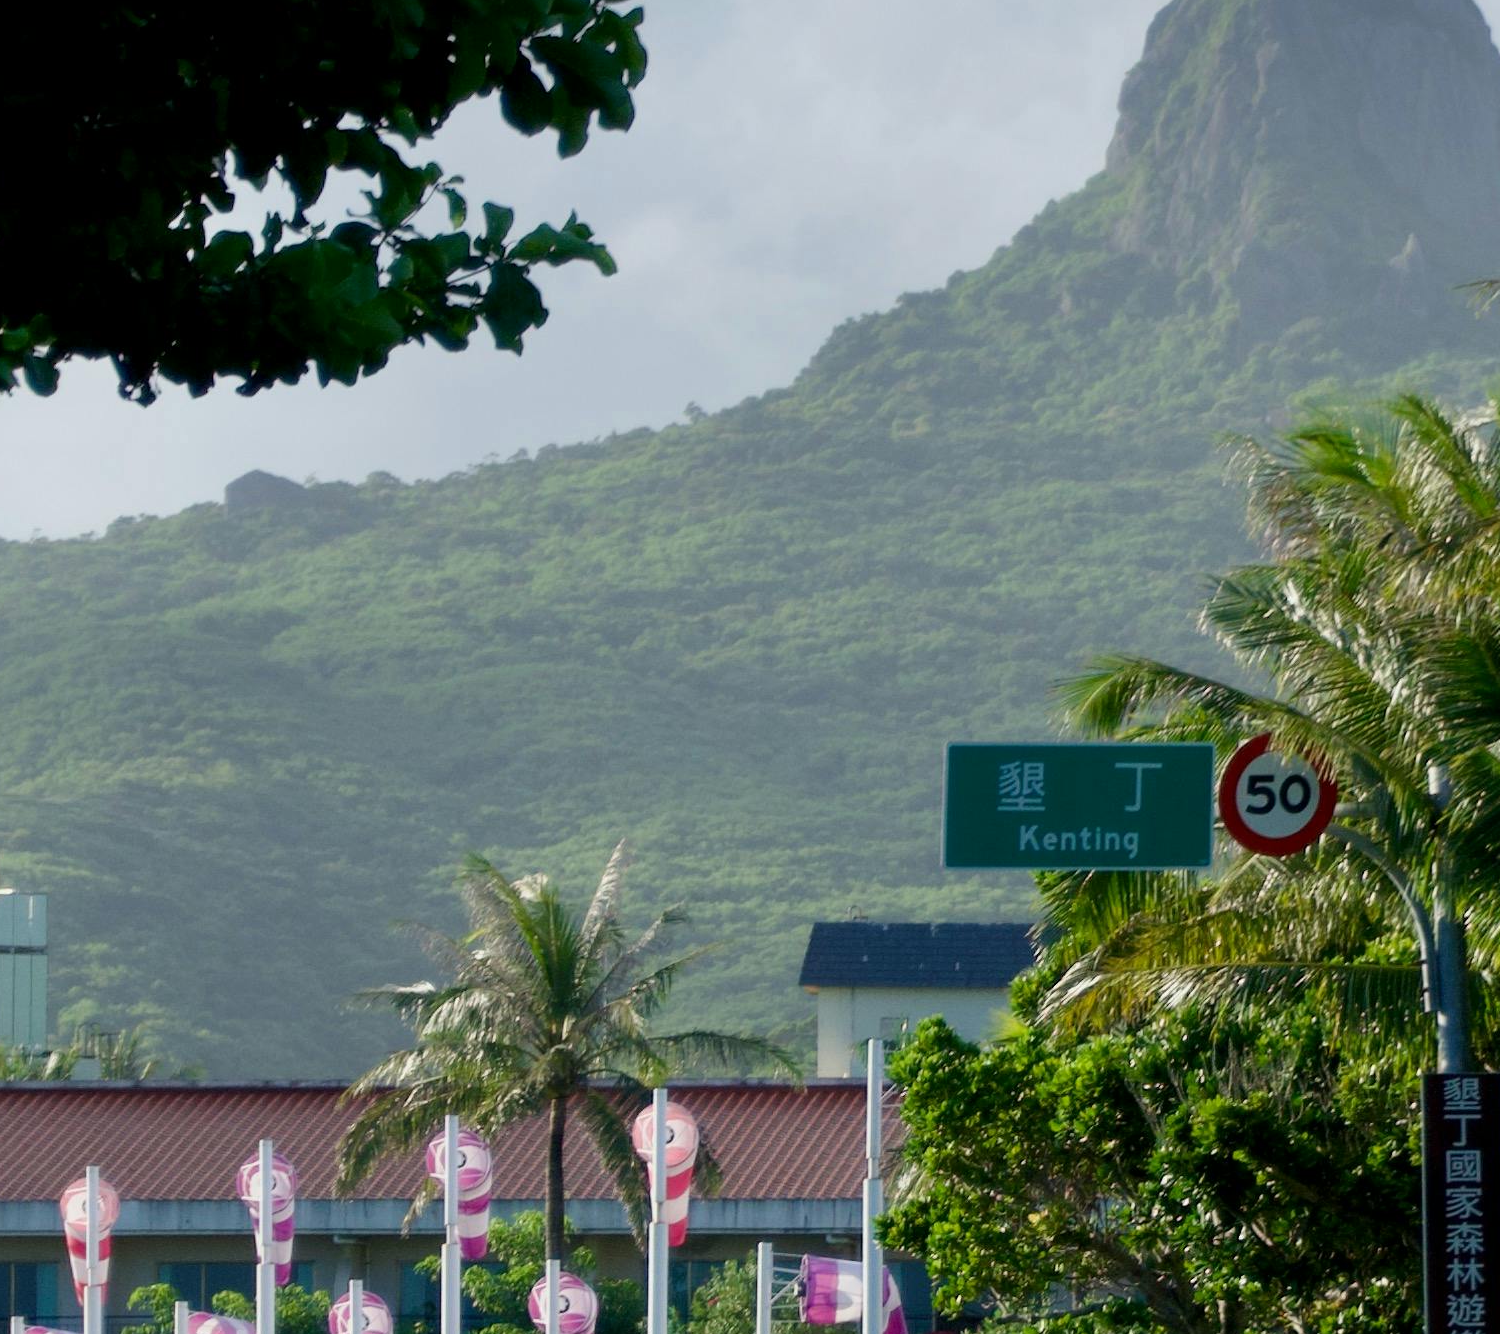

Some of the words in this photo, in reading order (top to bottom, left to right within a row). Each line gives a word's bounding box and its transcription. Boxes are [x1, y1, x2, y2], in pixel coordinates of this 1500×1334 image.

[997, 760, 1163, 813] 墾丁
[1245, 774, 1312, 815] 50
[1019, 825, 1140, 859] Kenting
